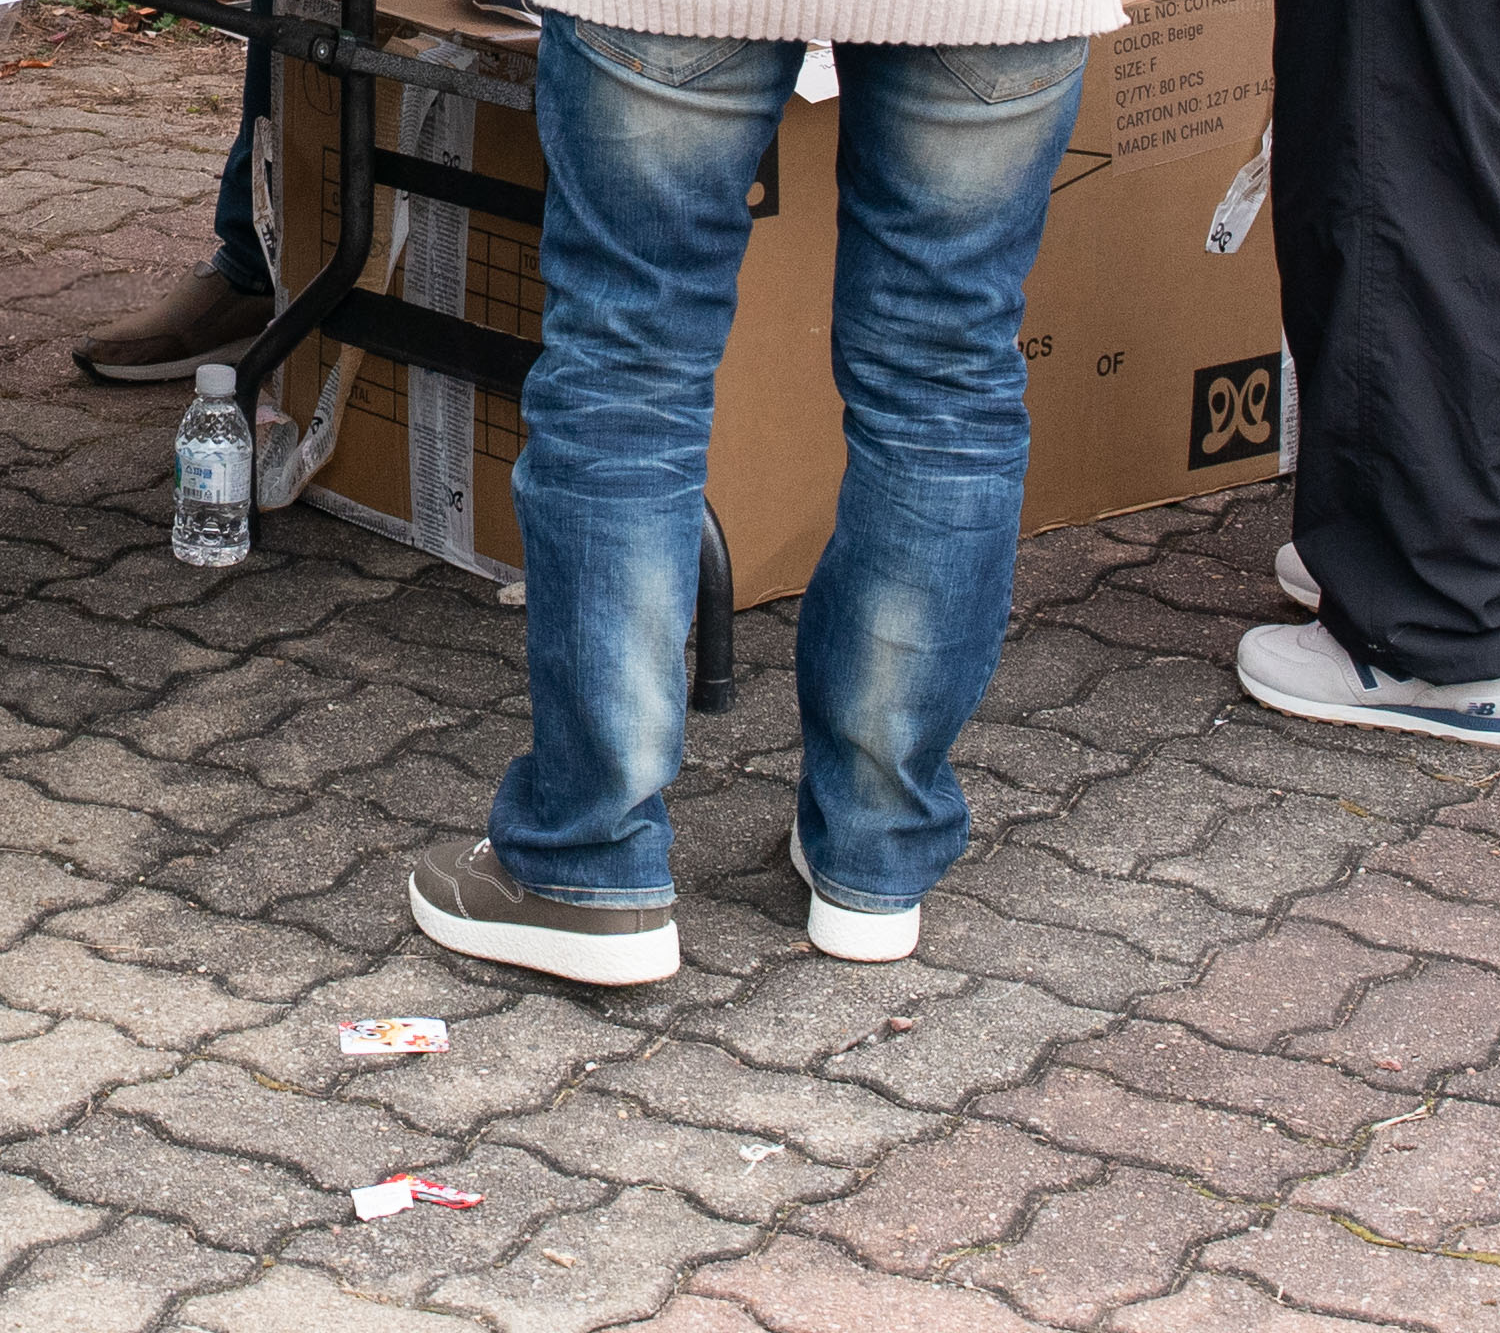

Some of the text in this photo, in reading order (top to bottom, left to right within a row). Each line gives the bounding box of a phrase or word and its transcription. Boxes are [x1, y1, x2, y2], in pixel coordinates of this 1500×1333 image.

[1126, 7, 1151, 26] YLE
[1155, 0, 1181, 20] NO:
[1113, 23, 1204, 55] COLOR: Beige
[1114, 56, 1158, 81] SIZE: F
[1159, 78, 1176, 95] 80
[1179, 70, 1205, 90] PCS
[1116, 103, 1174, 131] CARTON
[1177, 97, 1202, 116] NO:
[1206, 89, 1229, 110] 127
[1232, 84, 1251, 102] OF
[1117, 116, 1225, 157] MADE IN CHINA
[1096, 351, 1126, 377] OF
